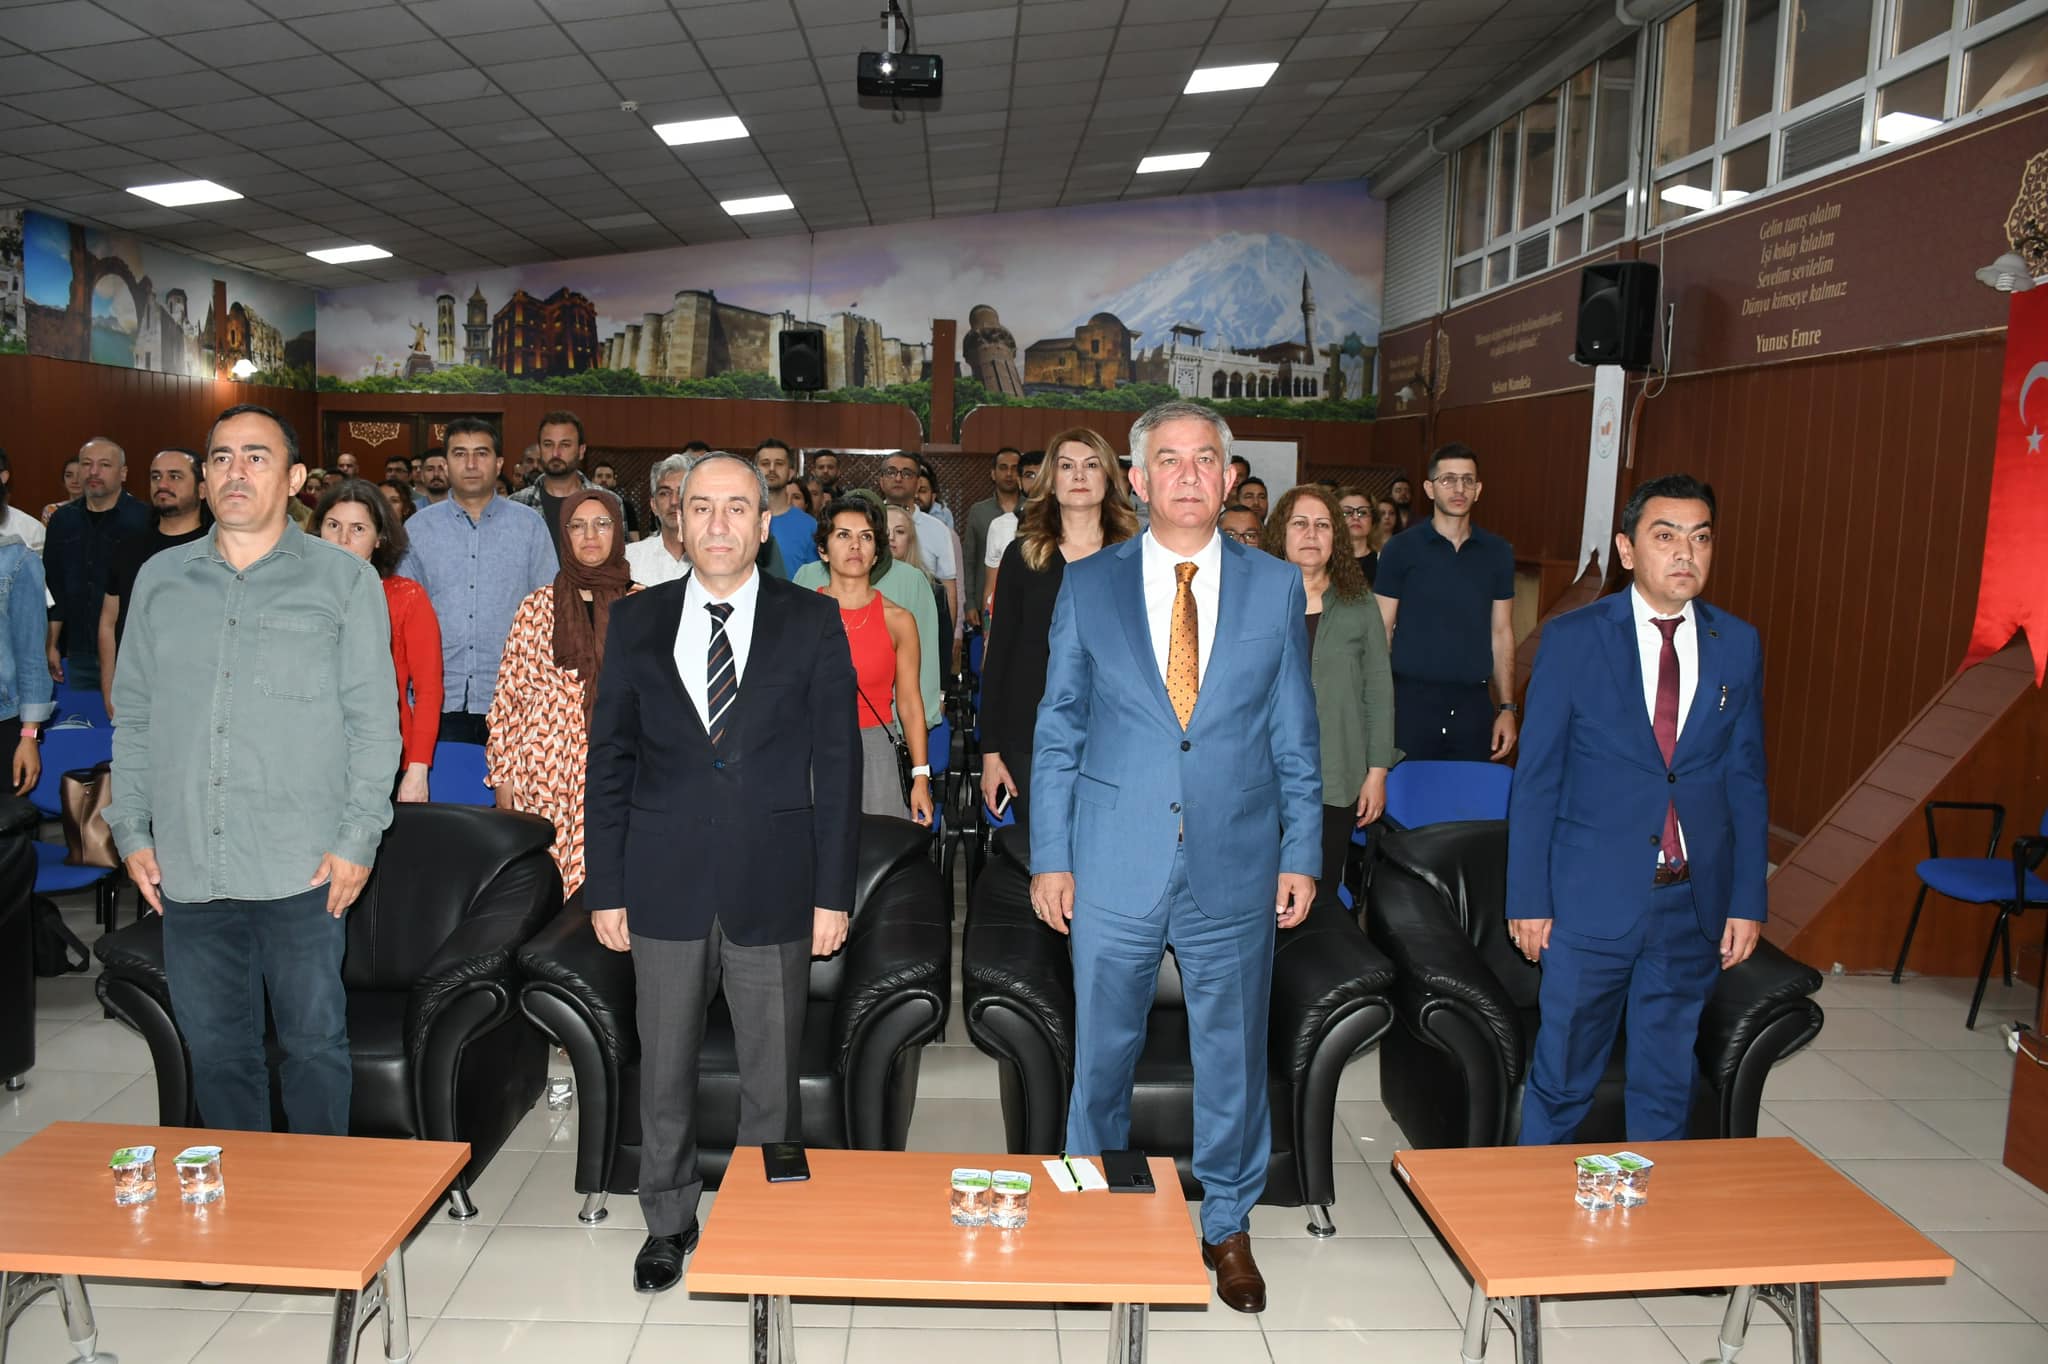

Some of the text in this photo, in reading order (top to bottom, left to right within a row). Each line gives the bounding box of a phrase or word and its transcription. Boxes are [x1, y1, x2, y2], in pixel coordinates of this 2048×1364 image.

[1760, 202, 1841, 240] Gelin tanış olalım
[1773, 240, 1798, 260] kolay
[1757, 256, 1834, 288] Sevelim sevilelim
[1742, 281, 1848, 317] Dünya kimseye kalmaz
[1756, 328, 1822, 352] Yunus Emre
